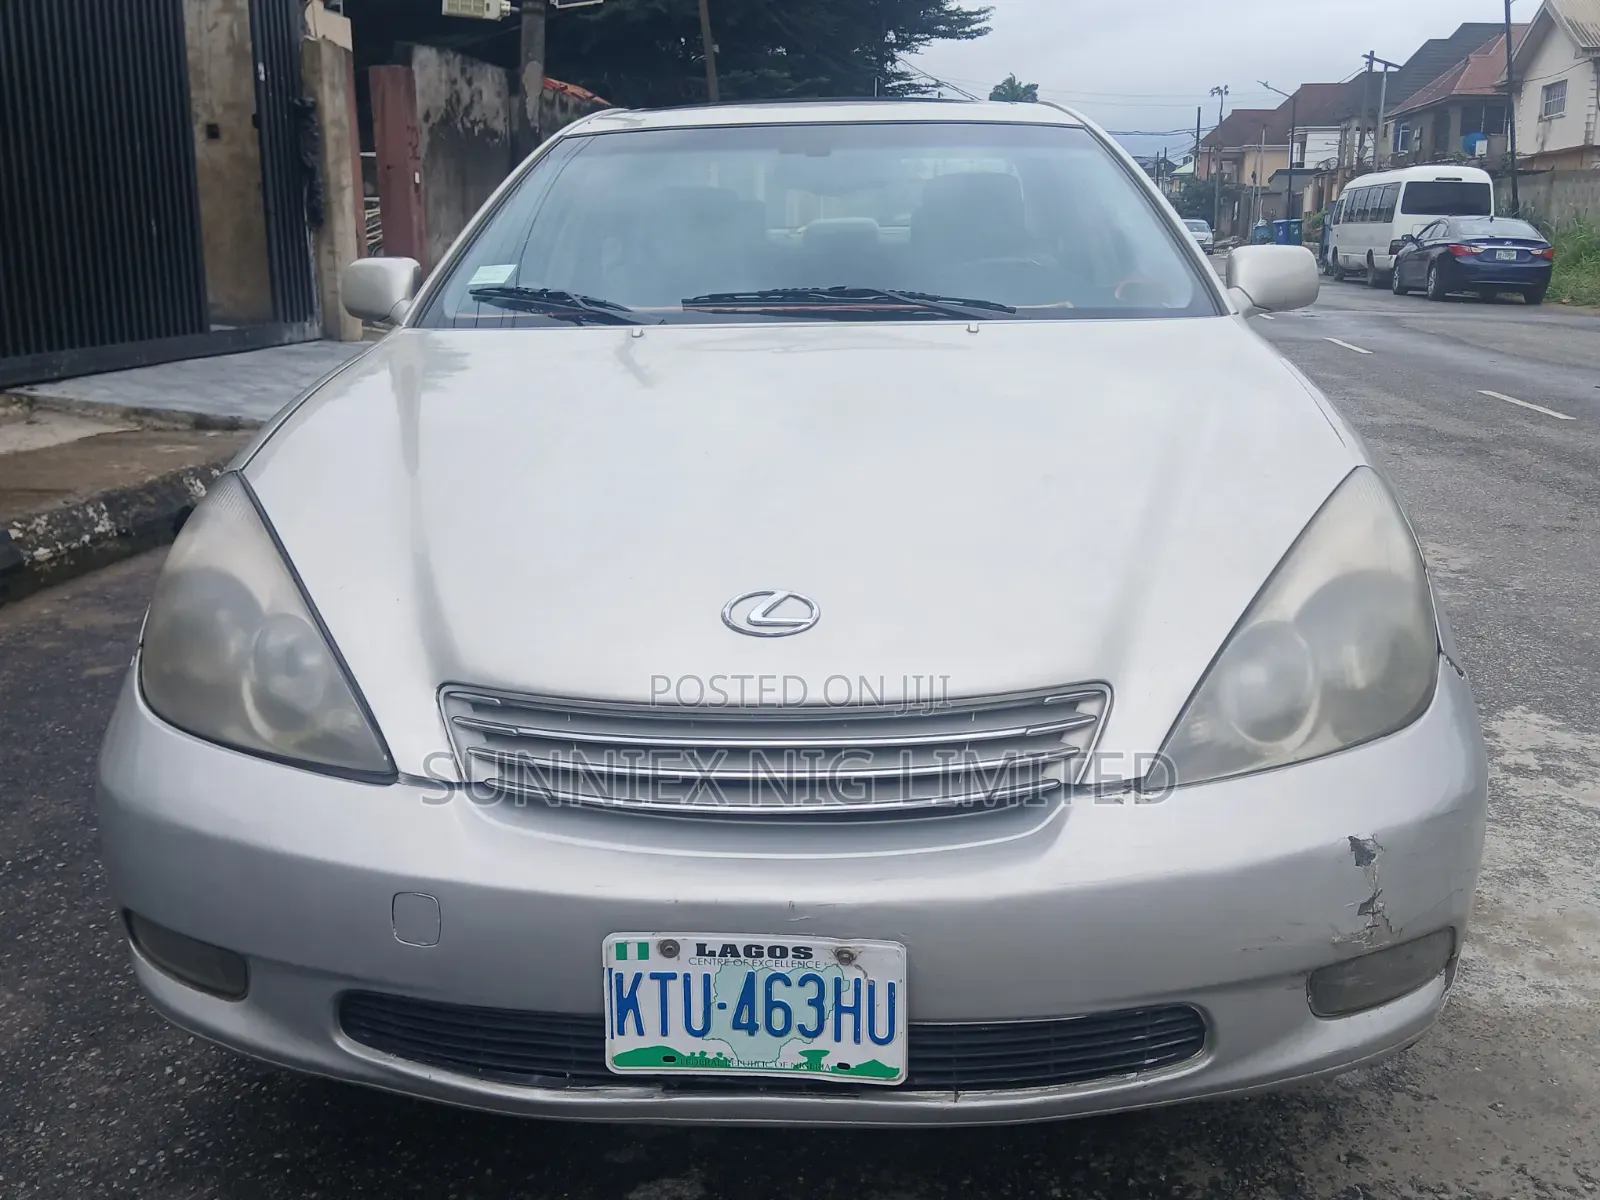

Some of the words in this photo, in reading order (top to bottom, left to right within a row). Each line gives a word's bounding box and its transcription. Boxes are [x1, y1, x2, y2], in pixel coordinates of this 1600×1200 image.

[695, 942, 814, 960] LAGOS
[688, 957, 730, 967] CENTRE
[732, 958, 749, 968] OF
[751, 959, 821, 969] EXCELLENCE
[614, 971, 896, 1046] KTU-463HU
[775, 1060, 789, 1069] OF
